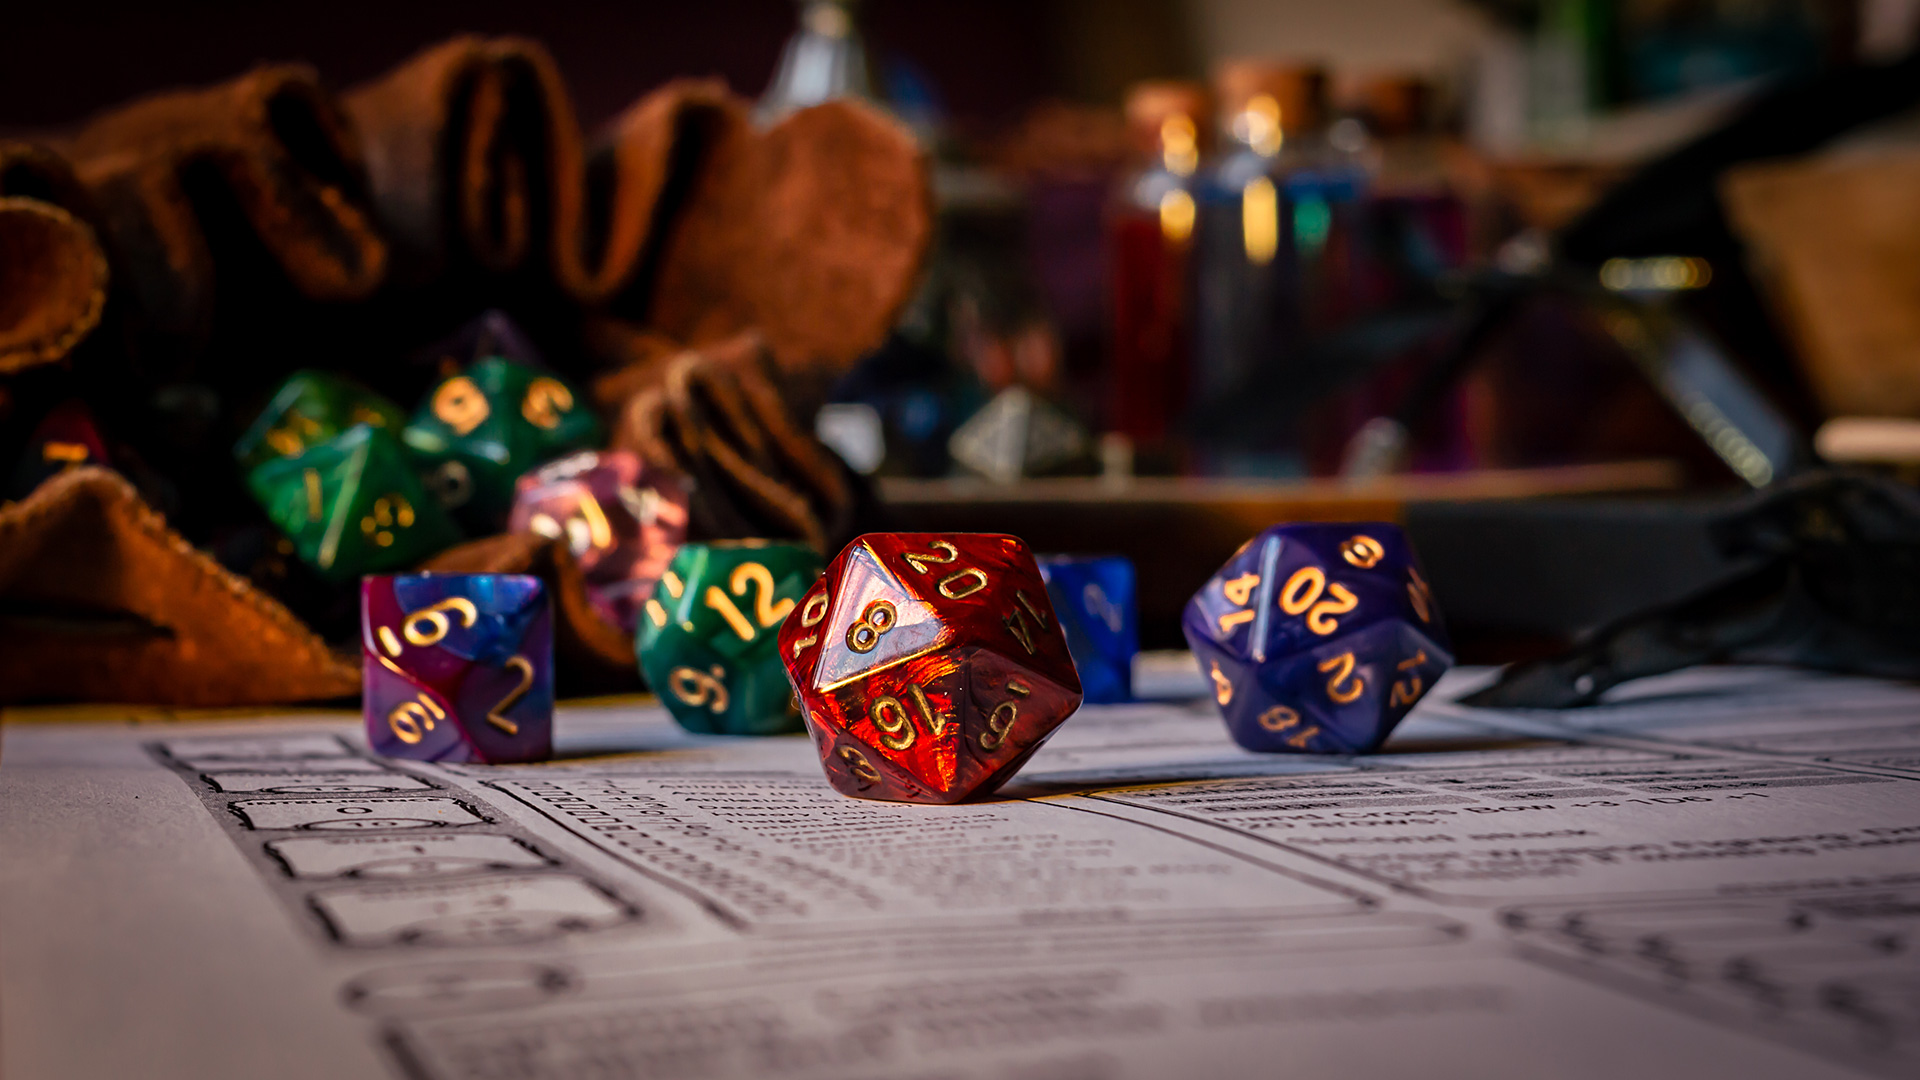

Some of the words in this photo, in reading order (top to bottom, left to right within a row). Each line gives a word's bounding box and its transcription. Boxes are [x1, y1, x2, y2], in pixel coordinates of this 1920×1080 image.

[704, 562, 796, 642] 12
[901, 540, 988, 600] 20
[1218, 572, 1261, 632] 14
[1279, 566, 1359, 636] 20
[794, 593, 830, 660] 10
[845, 599, 898, 654] 8
[485, 655, 535, 736] 2
[1316, 652, 1364, 704] 2
[868, 683, 947, 751] 16
